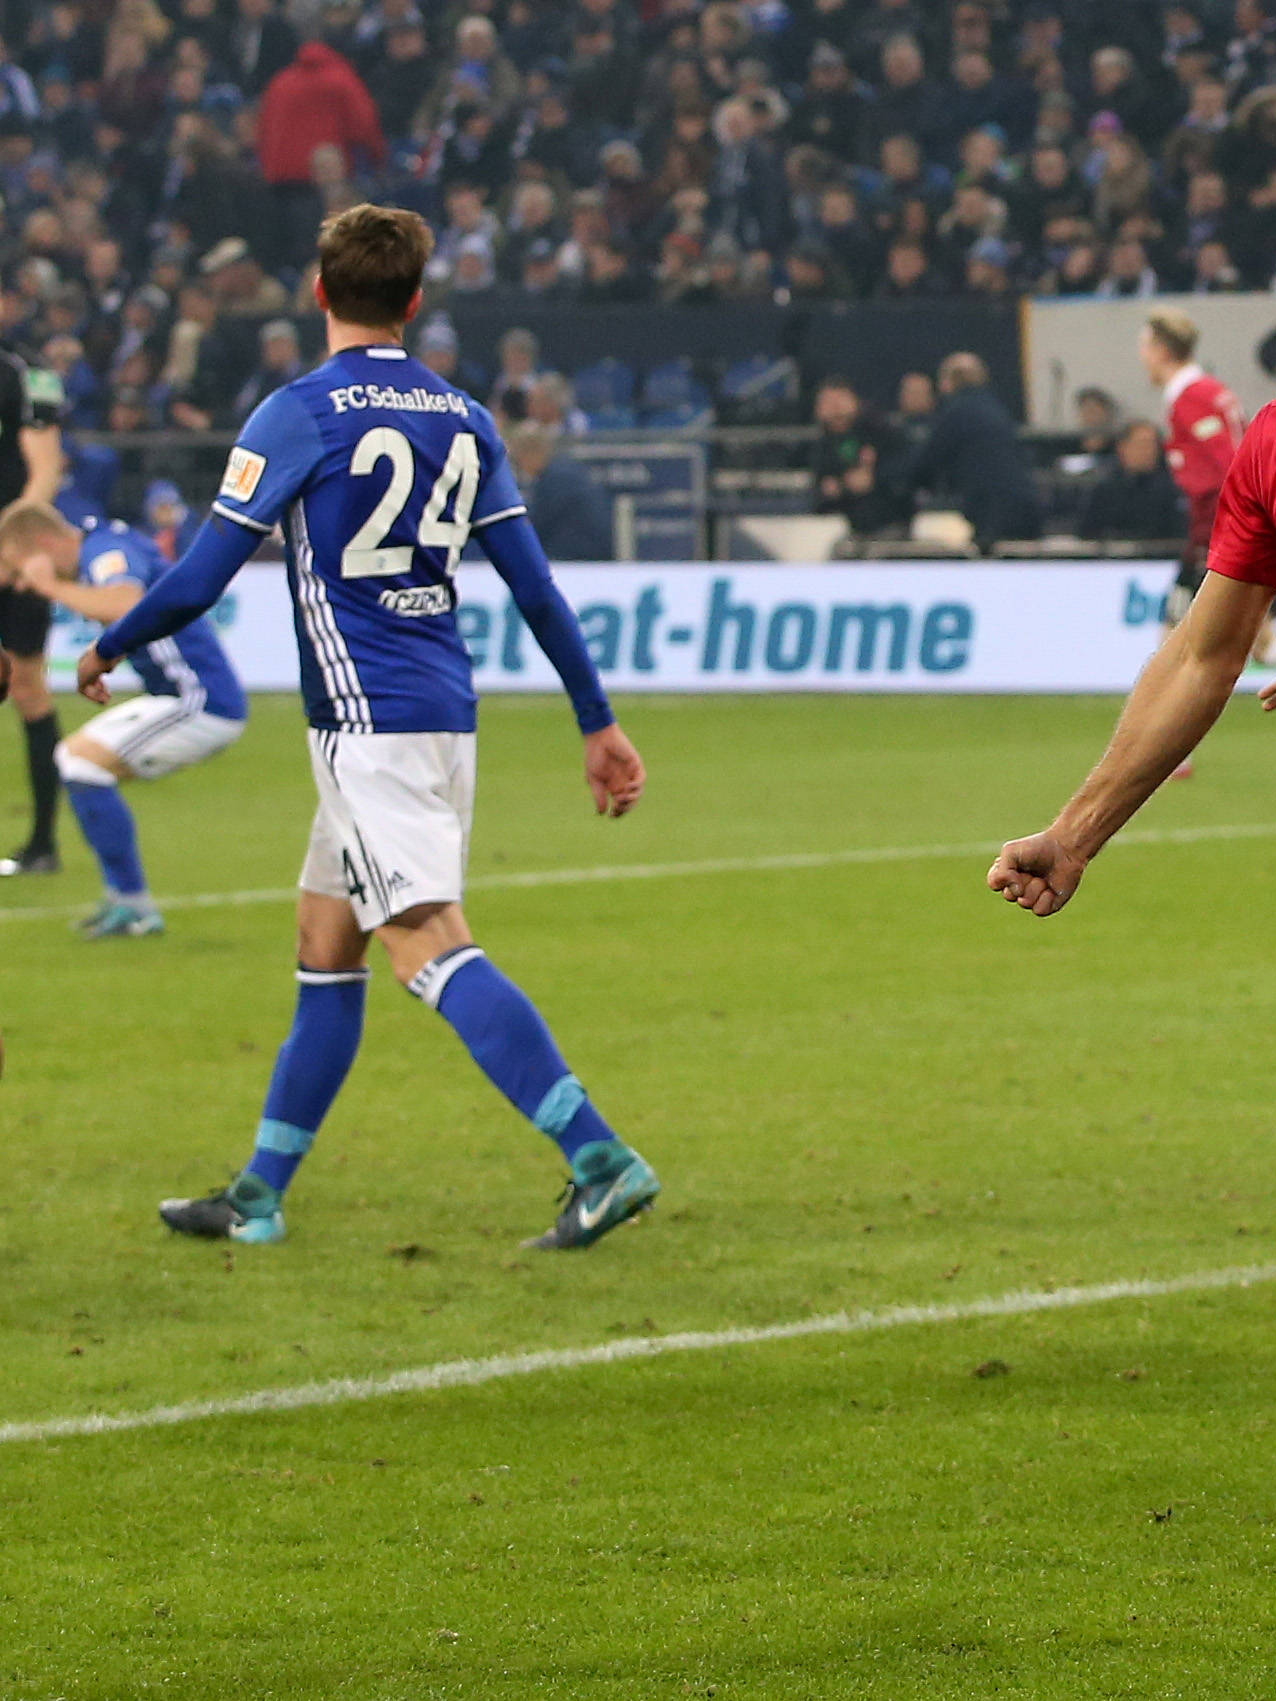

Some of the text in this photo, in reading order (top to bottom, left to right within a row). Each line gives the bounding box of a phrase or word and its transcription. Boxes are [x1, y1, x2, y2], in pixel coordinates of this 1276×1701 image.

[328, 384, 368, 414] FC
[366, 384, 448, 413] Schalke
[341, 426, 480, 579] 24
[456, 576, 975, 672] etat-home
